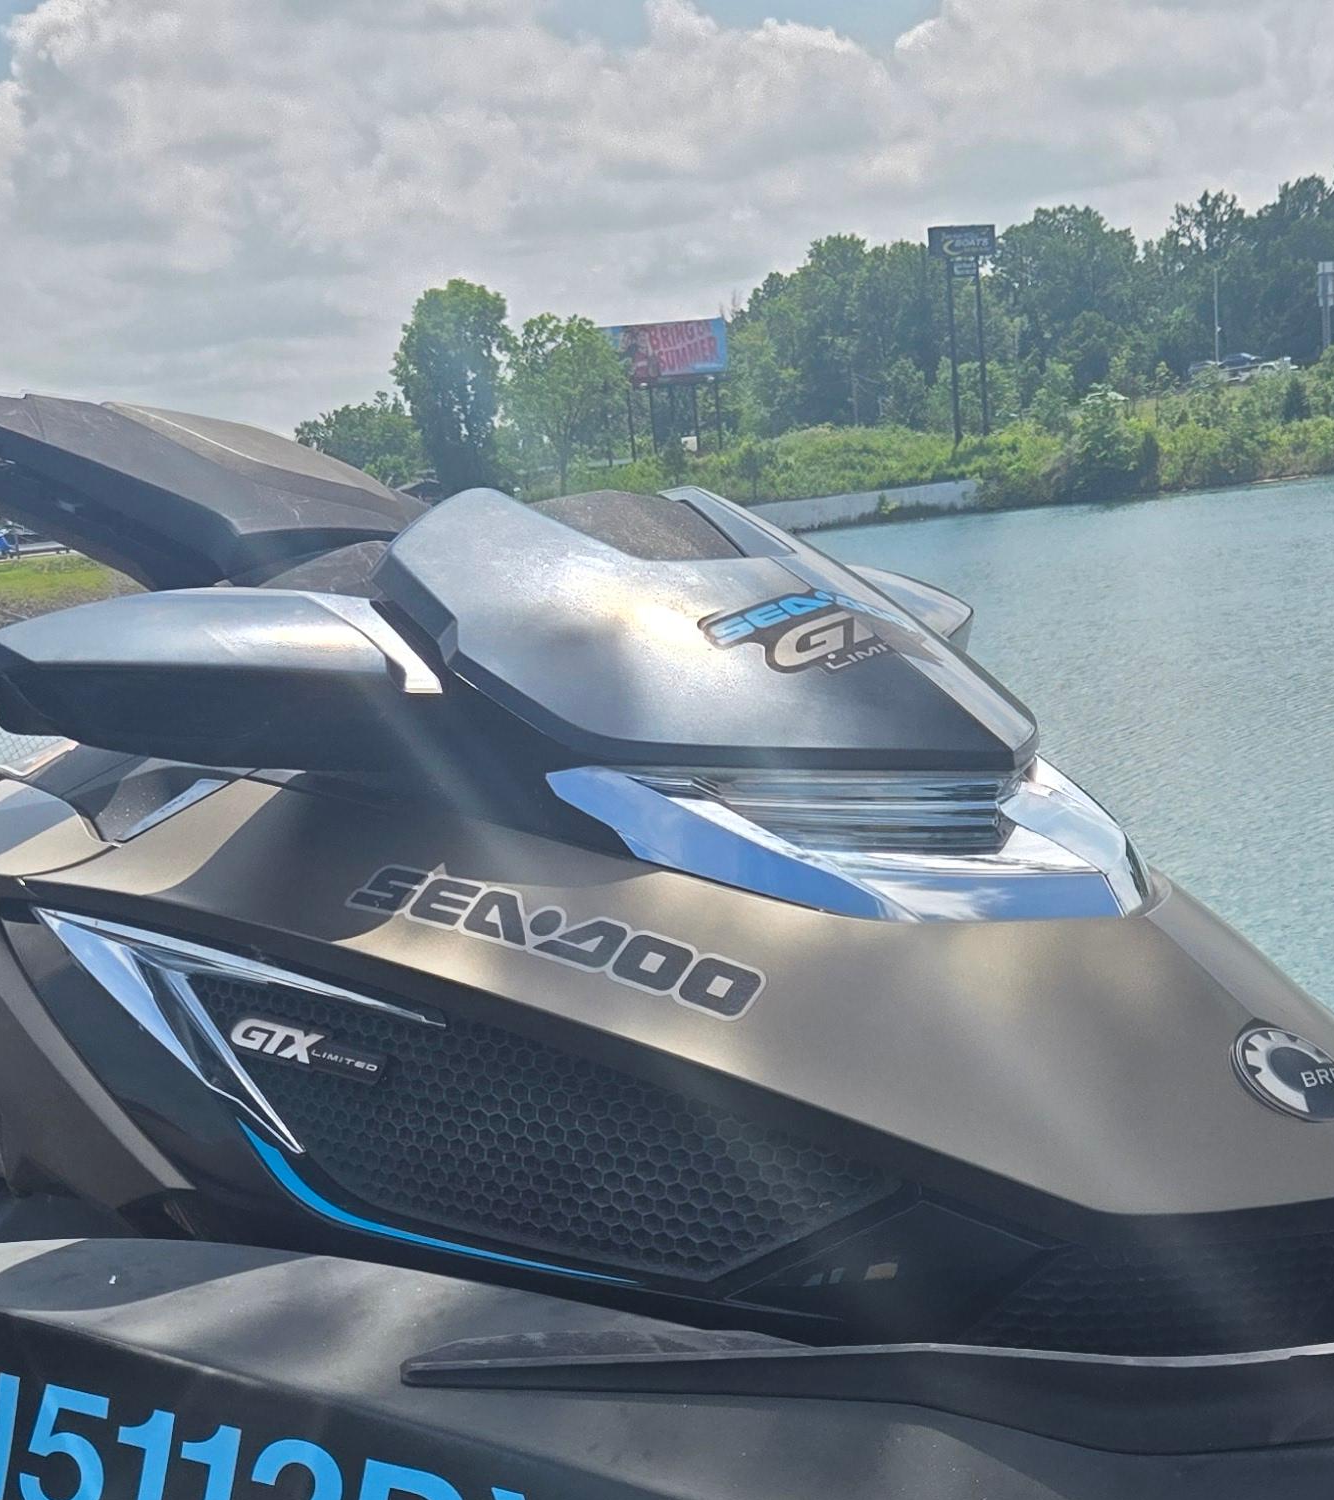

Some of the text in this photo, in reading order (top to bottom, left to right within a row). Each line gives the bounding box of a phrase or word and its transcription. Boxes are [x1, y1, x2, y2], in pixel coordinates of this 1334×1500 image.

[657, 336, 719, 372] SUMMER
[230, 1018, 378, 1073] GTX LIMITED
